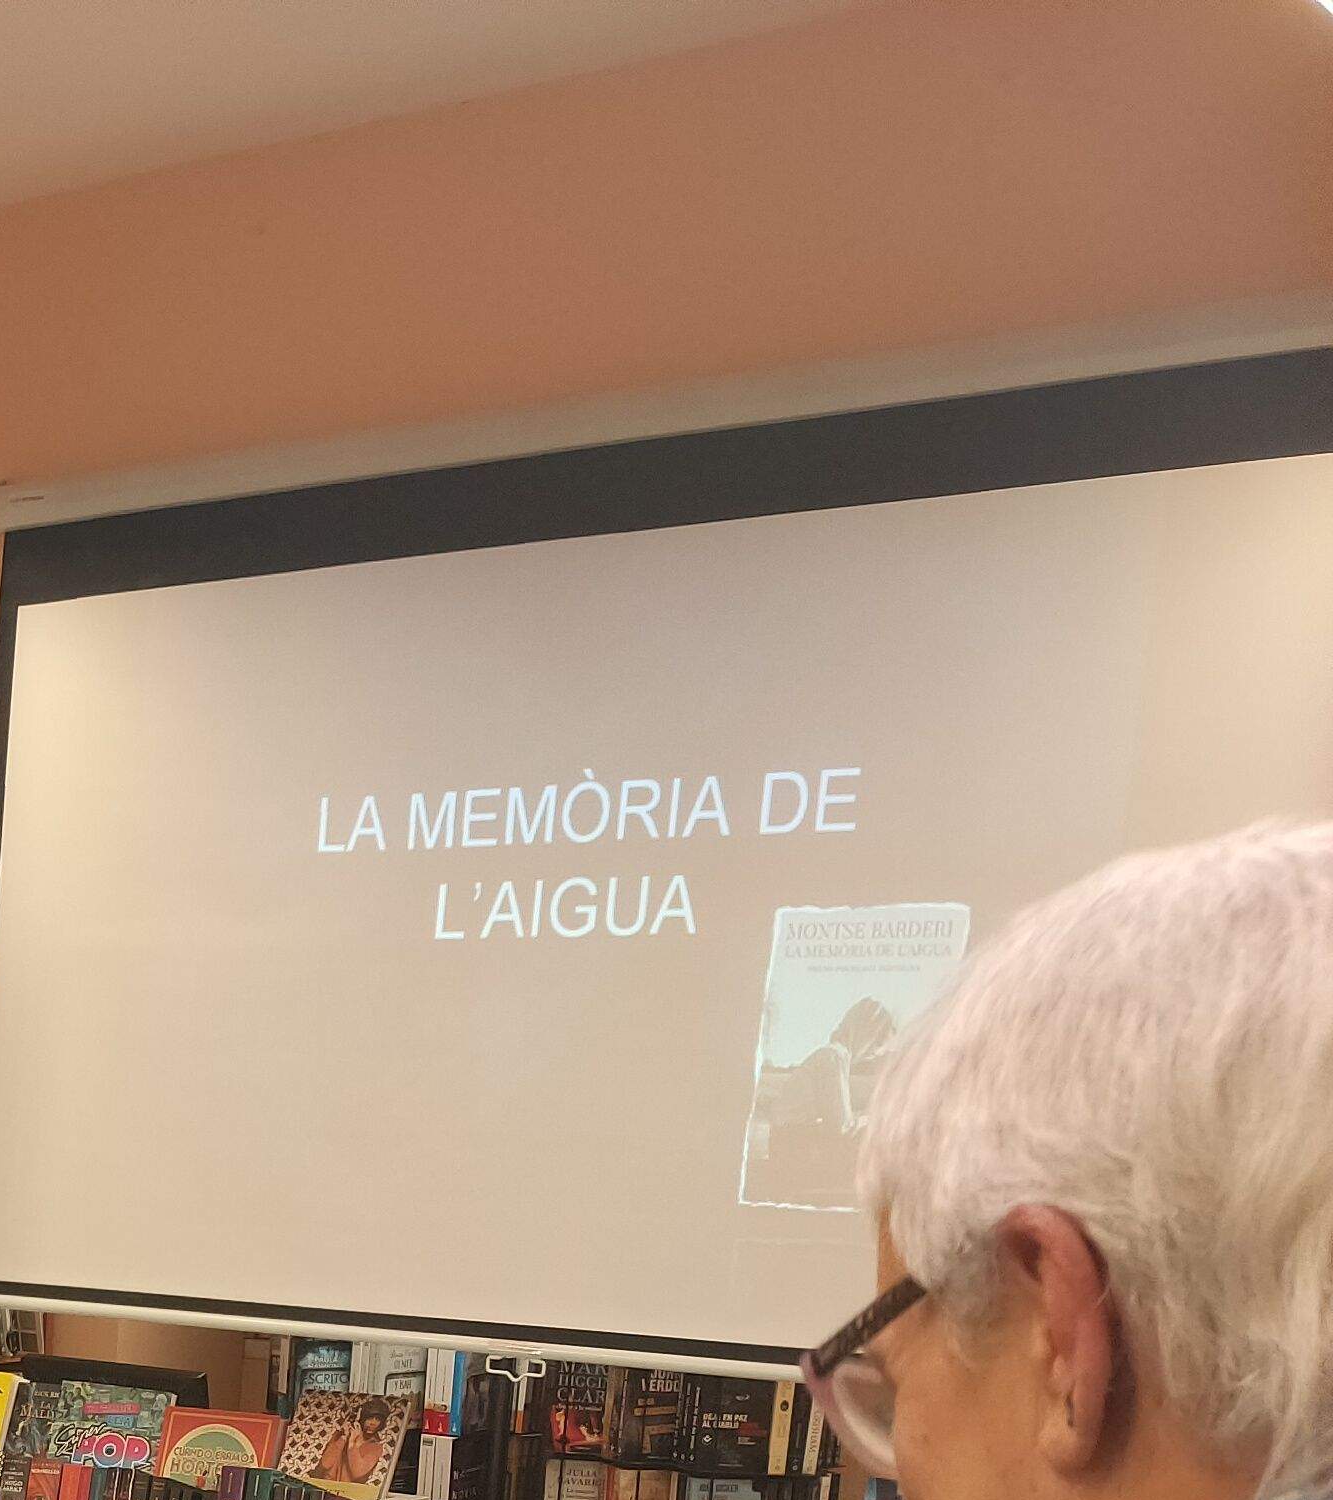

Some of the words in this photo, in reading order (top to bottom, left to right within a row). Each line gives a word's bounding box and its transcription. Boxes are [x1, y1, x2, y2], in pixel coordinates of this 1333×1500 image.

[317, 797, 387, 853] LA
[406, 768, 732, 850] MEMÒRIA
[758, 766, 862, 836] DE
[433, 874, 698, 941] L'AIGUA
[785, 919, 866, 942] MONTSE
[870, 918, 954, 941] BARDERI
[303, 1372, 350, 1385] ESCRITO
[54, 1422, 109, 1457] Super
[71, 1432, 152, 1470] POP
[173, 1446, 213, 1459] CUANDO
